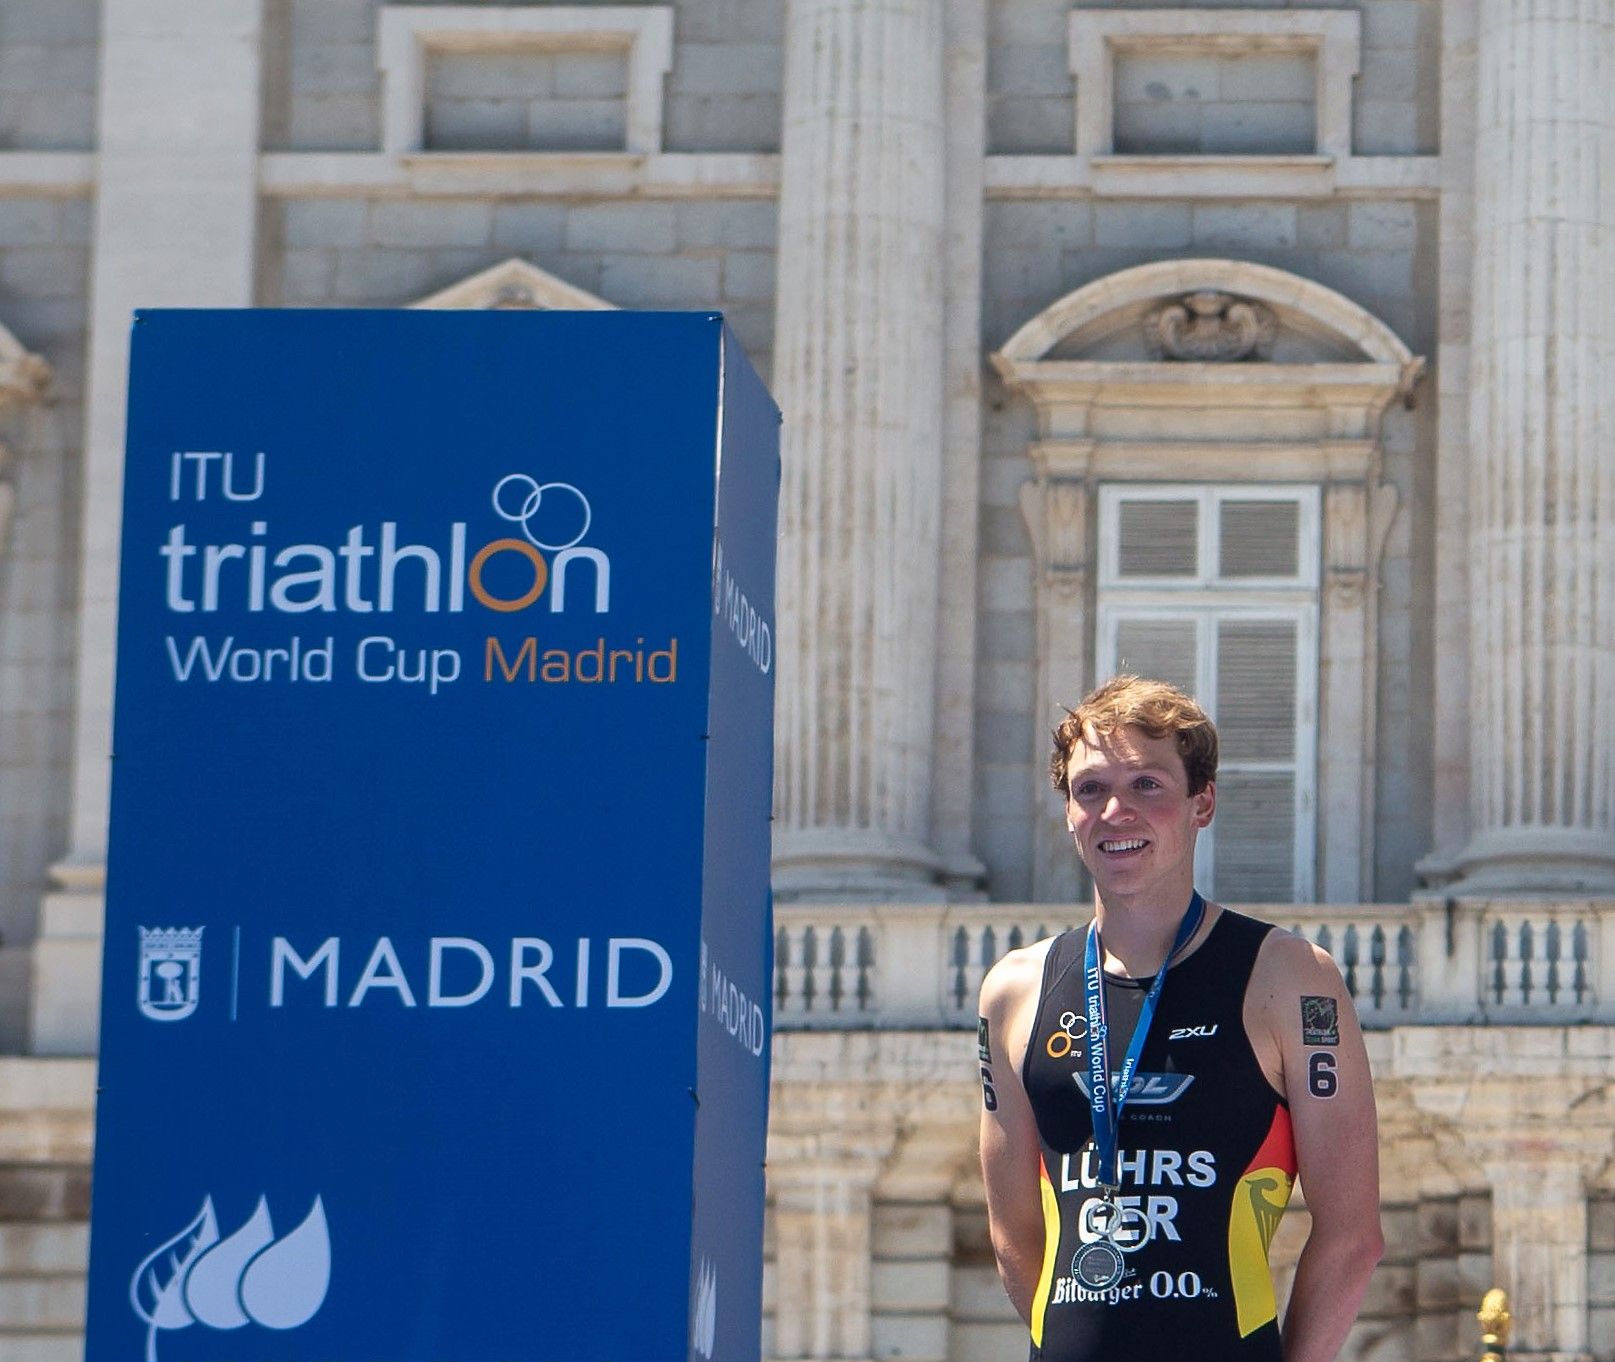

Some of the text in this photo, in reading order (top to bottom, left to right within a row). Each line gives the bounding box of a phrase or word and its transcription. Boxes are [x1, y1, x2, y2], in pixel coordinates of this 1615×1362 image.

[169, 452, 266, 502] ITU
[160, 520, 611, 614] triathlon
[725, 568, 771, 675] MADRID
[164, 635, 679, 695] World Cup Madrid
[268, 936, 674, 1010] MADRID
[1087, 966, 1100, 991] ITU
[711, 961, 765, 1058] MADRID
[1168, 1023, 1219, 1041] 2XU
[1090, 1042, 1104, 1080] World
[1308, 1050, 1339, 1100] 6
[981, 1066, 999, 1113] 6
[1093, 1085, 1107, 1113] Cup
